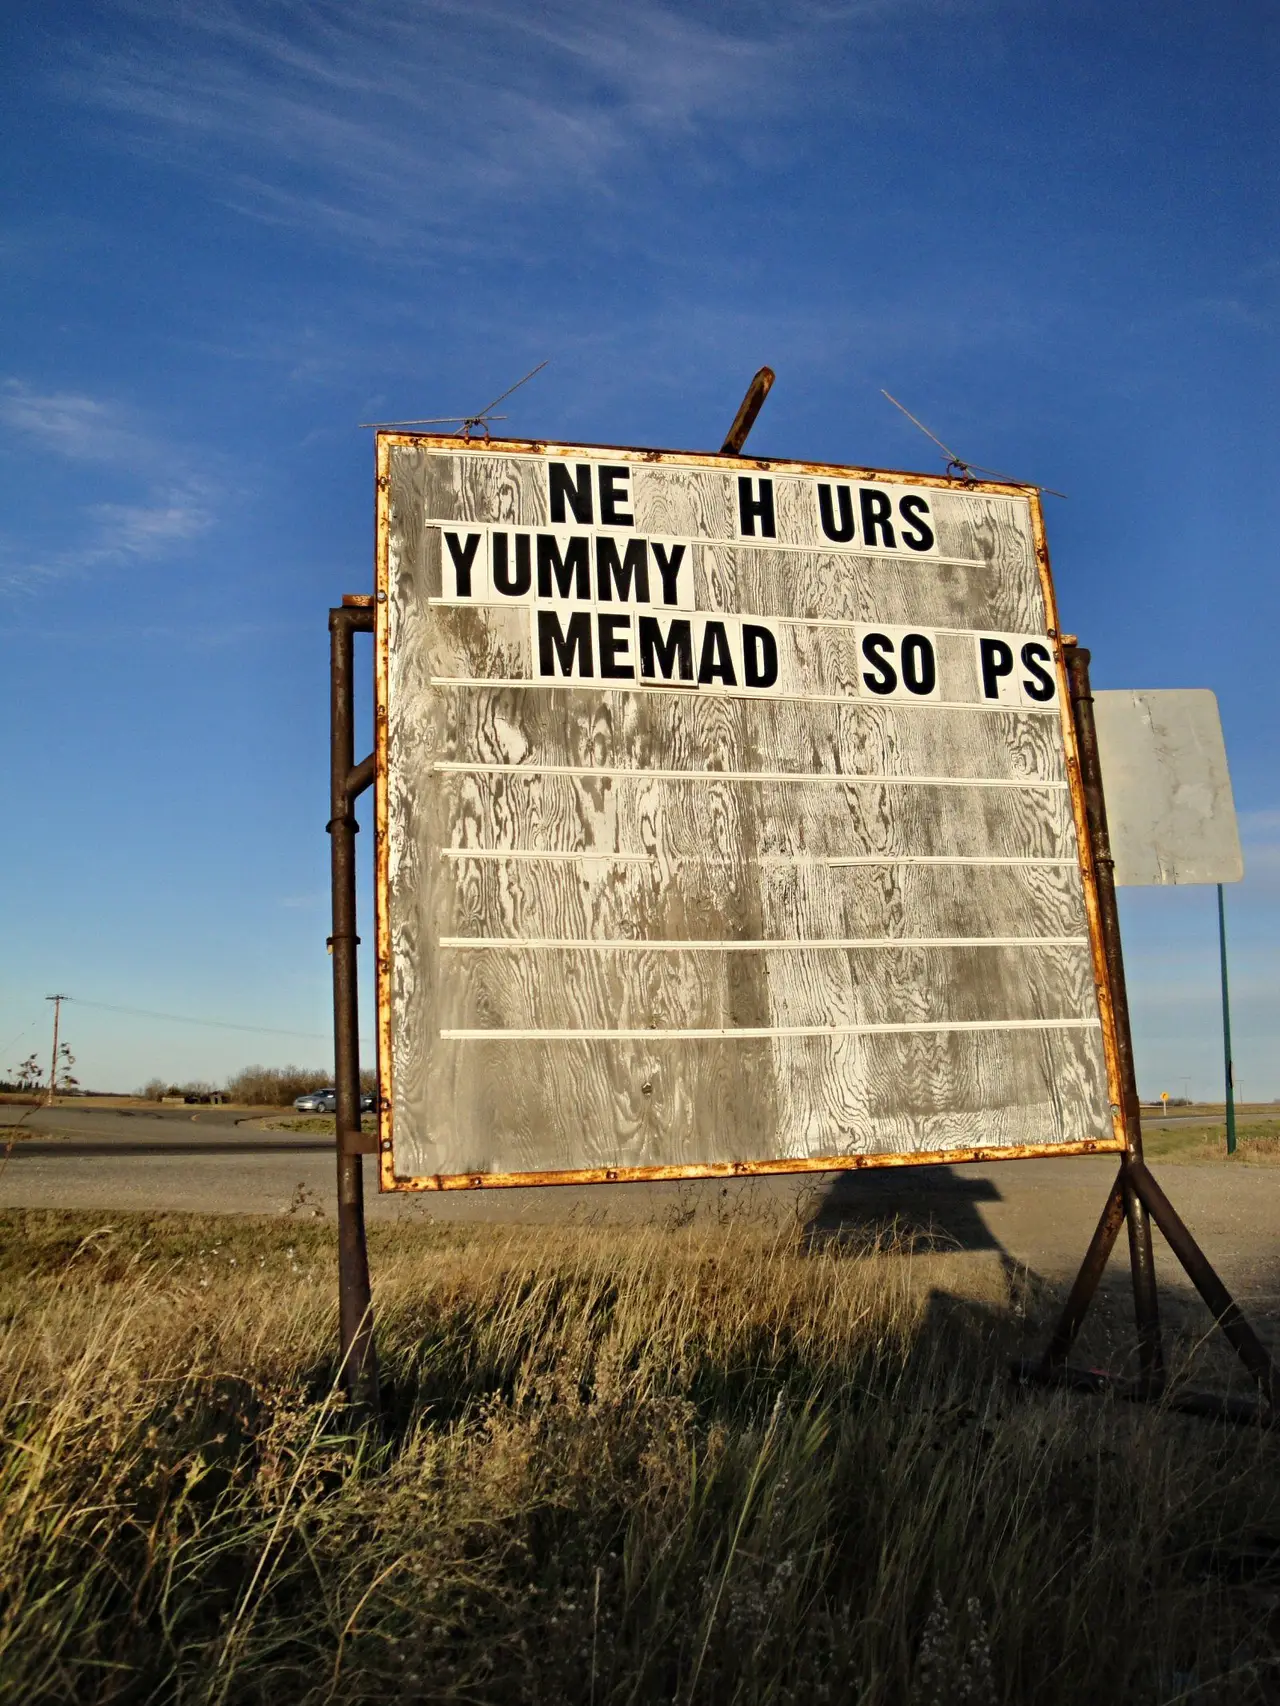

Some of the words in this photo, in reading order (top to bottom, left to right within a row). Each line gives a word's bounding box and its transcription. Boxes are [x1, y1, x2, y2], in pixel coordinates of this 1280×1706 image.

[548, 462, 634, 527] NE
[443, 531, 686, 606] YUMMY
[537, 610, 778, 688] MEMAD
